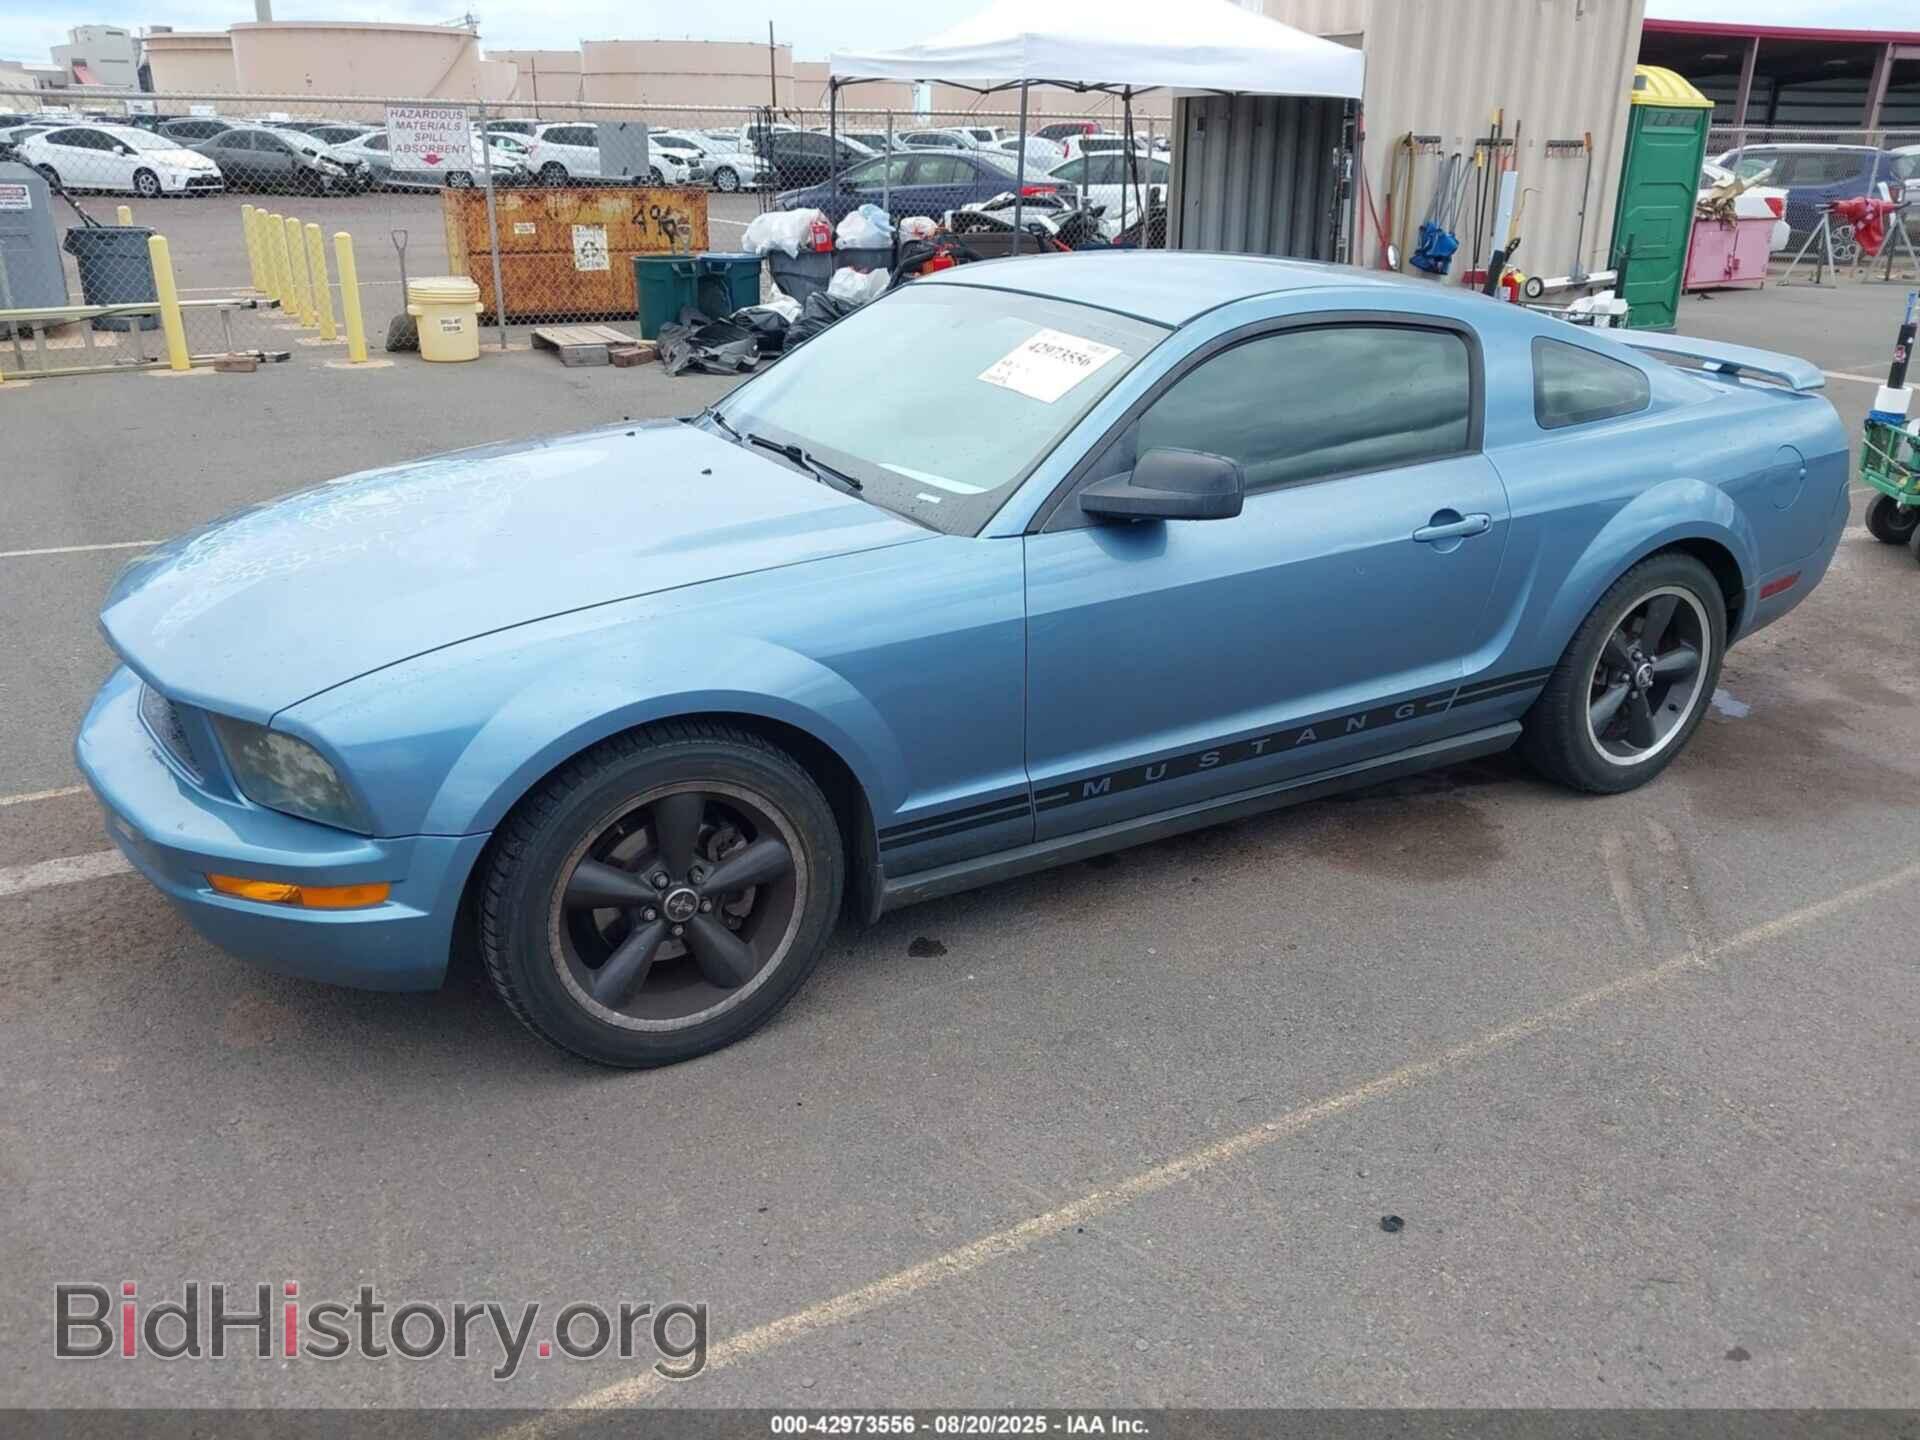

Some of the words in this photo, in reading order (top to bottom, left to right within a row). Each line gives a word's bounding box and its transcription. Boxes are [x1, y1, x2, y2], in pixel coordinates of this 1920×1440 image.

[390, 109, 463, 120] HAZARDOUS
[395, 121, 461, 131] MATERIALS
[414, 132, 447, 142] SPILL
[395, 143, 466, 154] ABSORBENT
[1082, 703, 1416, 797] MUSTANG
